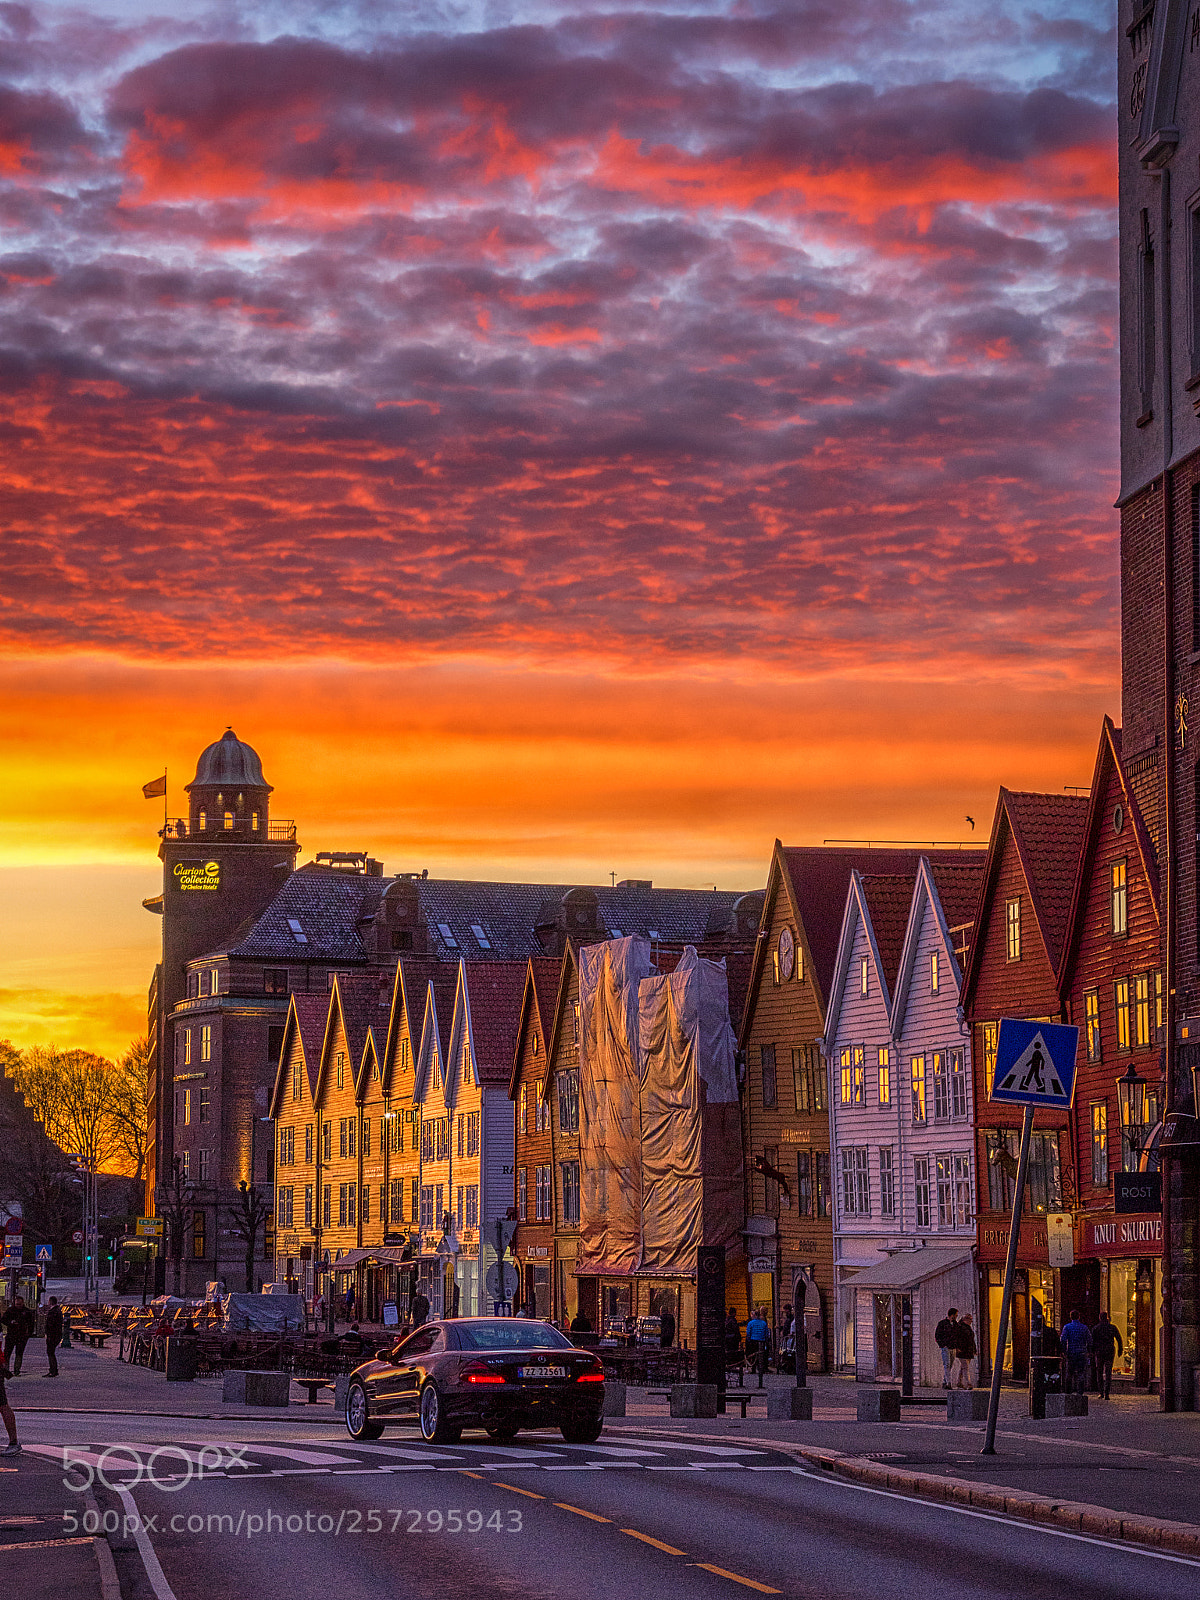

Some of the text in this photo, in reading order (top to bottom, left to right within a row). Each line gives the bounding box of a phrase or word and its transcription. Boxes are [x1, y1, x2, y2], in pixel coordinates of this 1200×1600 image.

[173, 863, 204, 876] Clarion
[180, 875, 220, 884] Collection
[1094, 1220, 1163, 1245] KNUT SKURTVE
